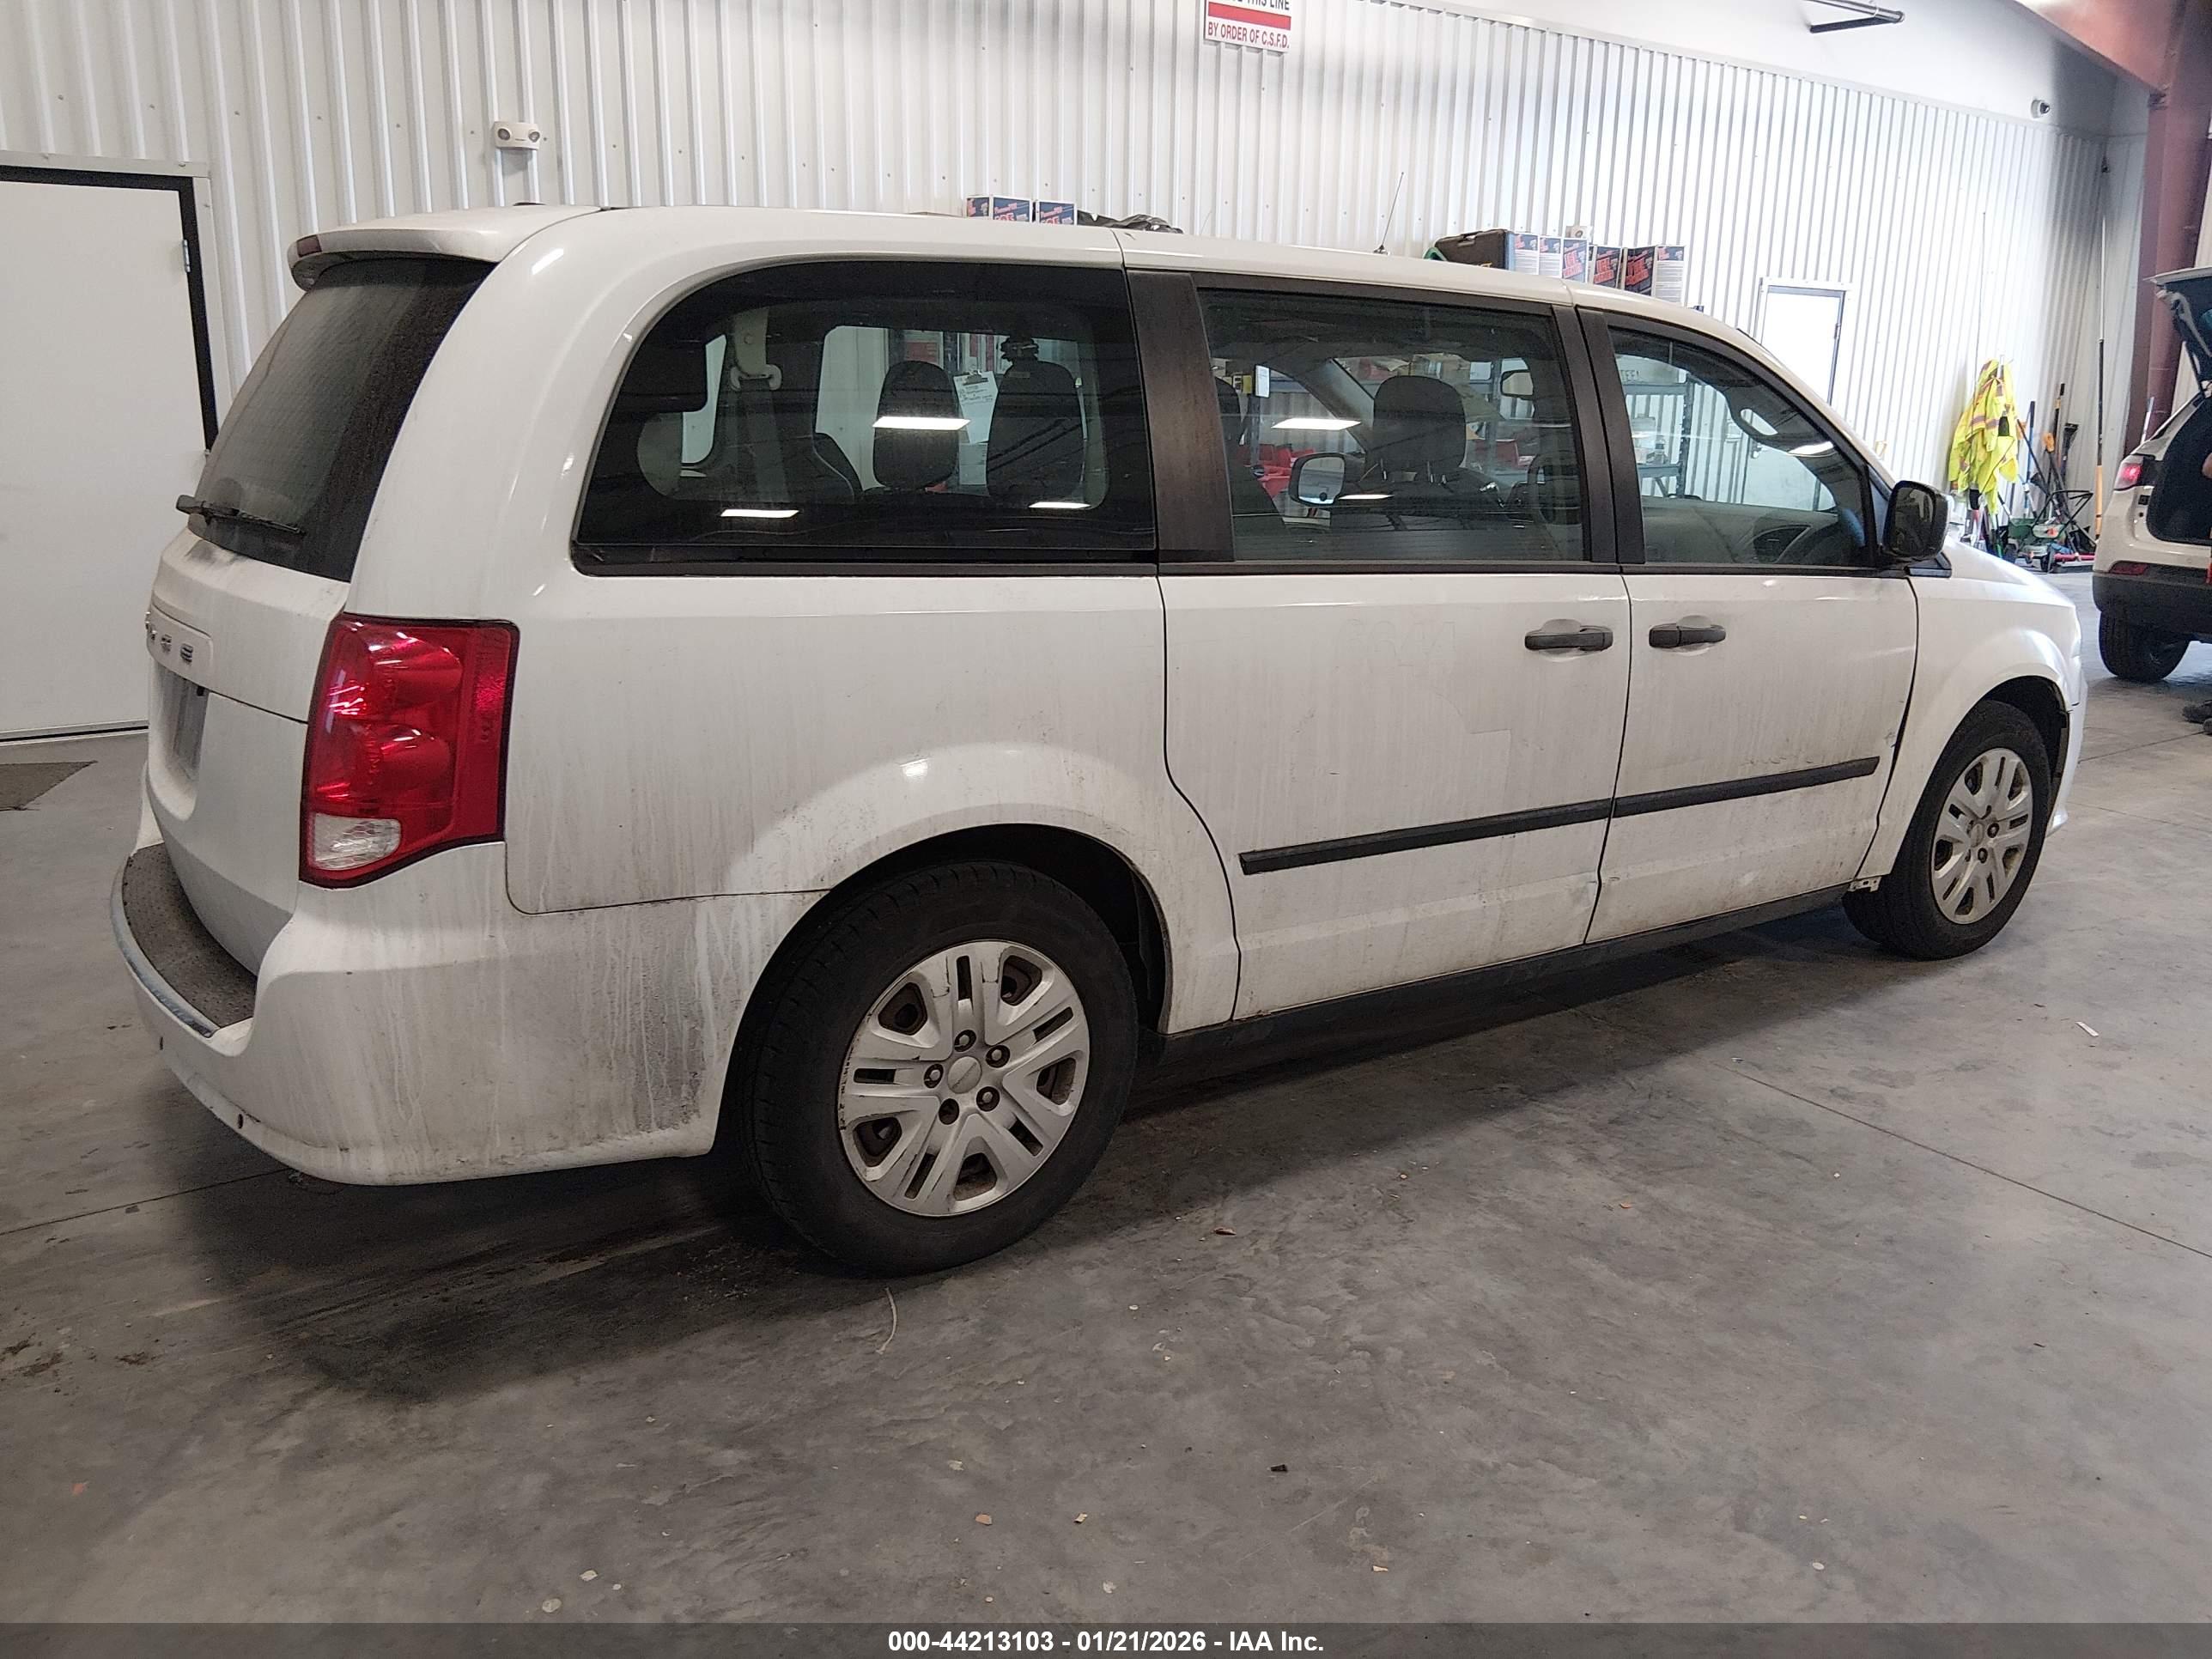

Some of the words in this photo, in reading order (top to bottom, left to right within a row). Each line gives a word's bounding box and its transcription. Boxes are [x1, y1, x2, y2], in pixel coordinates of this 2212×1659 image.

[1207, 21, 1218, 36] BY
[1220, 24, 1248, 41] ORDER
[1249, 28, 1260, 44] OF
[1261, 31, 1290, 48] C.S.F.D.
